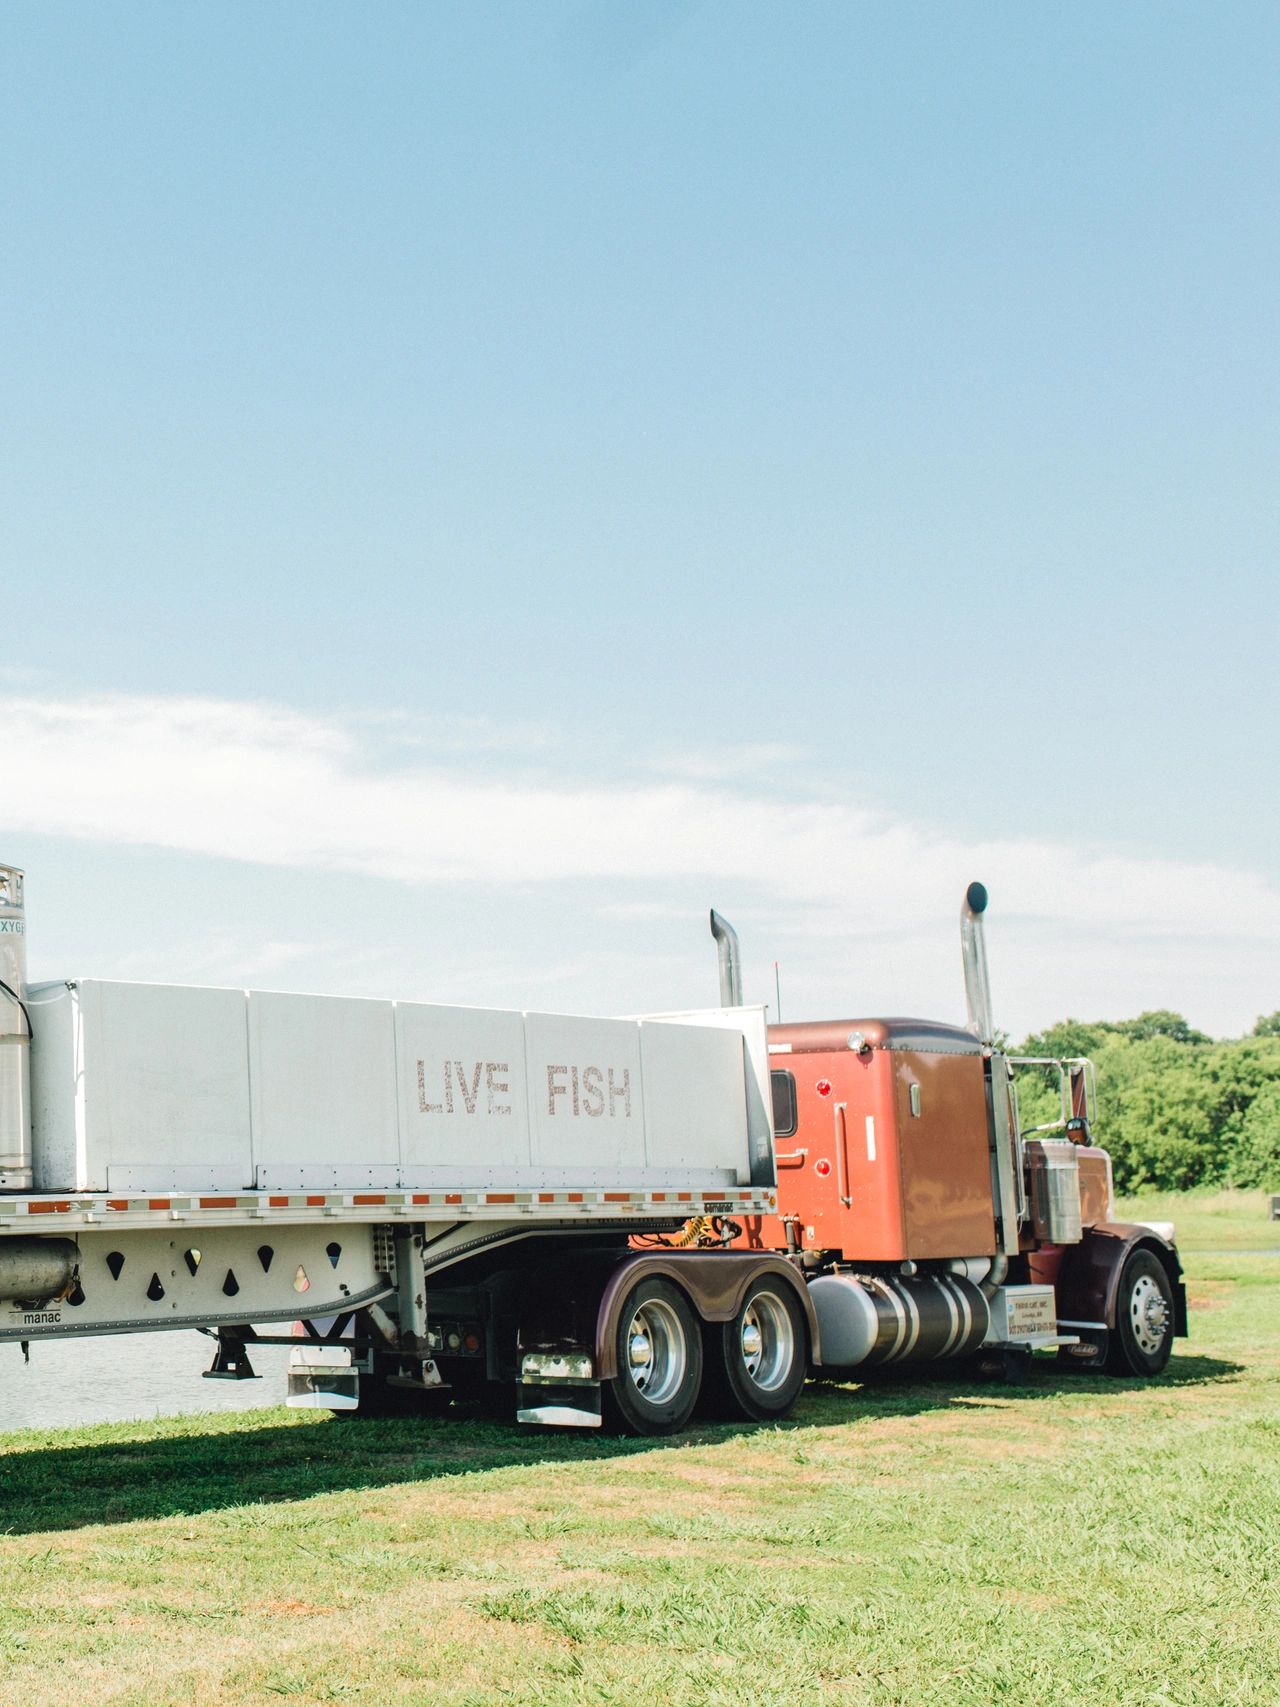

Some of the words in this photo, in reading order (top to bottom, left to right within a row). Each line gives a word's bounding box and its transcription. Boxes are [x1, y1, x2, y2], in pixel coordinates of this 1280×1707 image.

[417, 1059, 512, 1115] LIVE
[547, 1065, 631, 1118] FISH
[24, 1313, 61, 1324] manac
